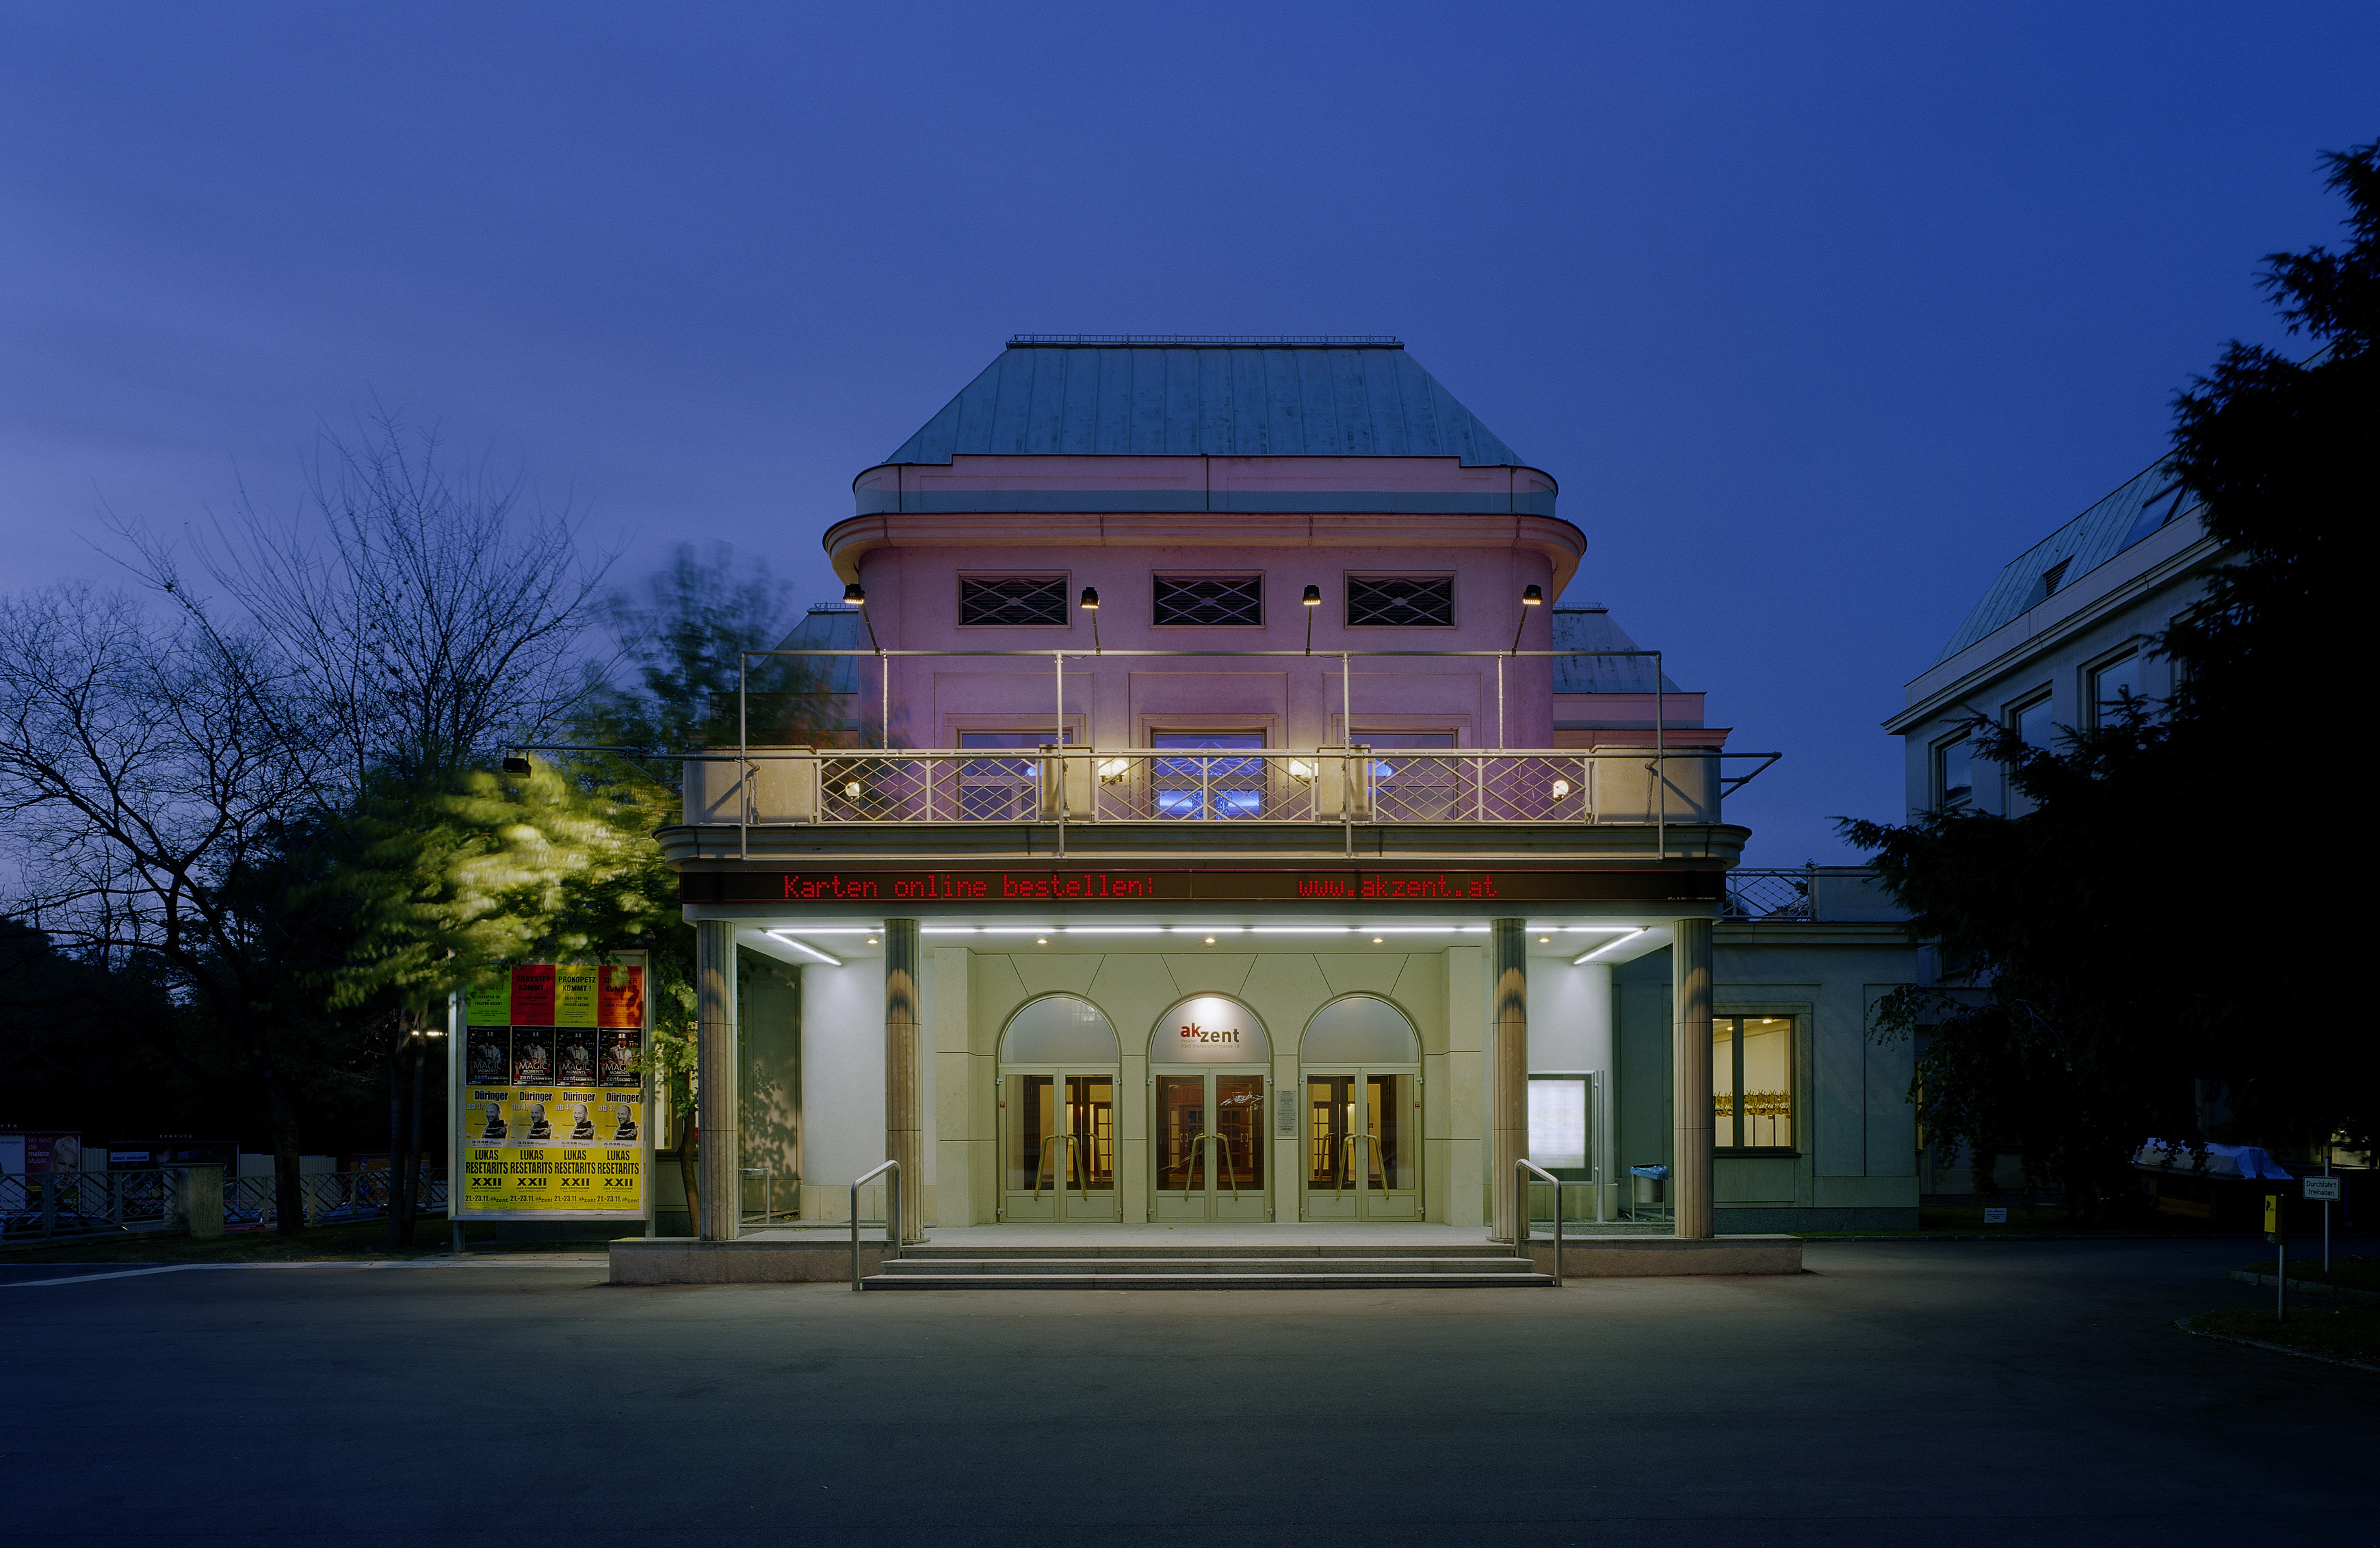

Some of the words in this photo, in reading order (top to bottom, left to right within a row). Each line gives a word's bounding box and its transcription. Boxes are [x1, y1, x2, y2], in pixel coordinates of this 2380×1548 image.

[784, 874, 878, 899] Karten
[893, 874, 986, 897] online
[1003, 874, 1153, 897] bestellen!
[1298, 874, 1499, 898] www.akzent.at
[1180, 1023, 1240, 1042] akzent
[519, 1062, 548, 1070] MAGIC
[474, 1090, 508, 1101] Düringer
[519, 1091, 553, 1102] Düringer
[563, 1092, 596, 1103] Düringer
[606, 1092, 640, 1103] Düringer
[475, 1149, 499, 1160] LUKAS
[520, 1149, 543, 1160] LUKAS
[564, 1150, 586, 1161] LUKAS
[607, 1150, 630, 1161] LUKAS
[465, 1162, 508, 1174] RESETARITS
[510, 1162, 553, 1174] RESETARITS
[554, 1162, 596, 1175] RESETARITS
[597, 1162, 639, 1175] RESETARITS
[471, 1177, 501, 1186] XXII
[516, 1178, 547, 1186] XXII
[561, 1178, 590, 1186] XXII
[603, 1178, 633, 1187] XXII
